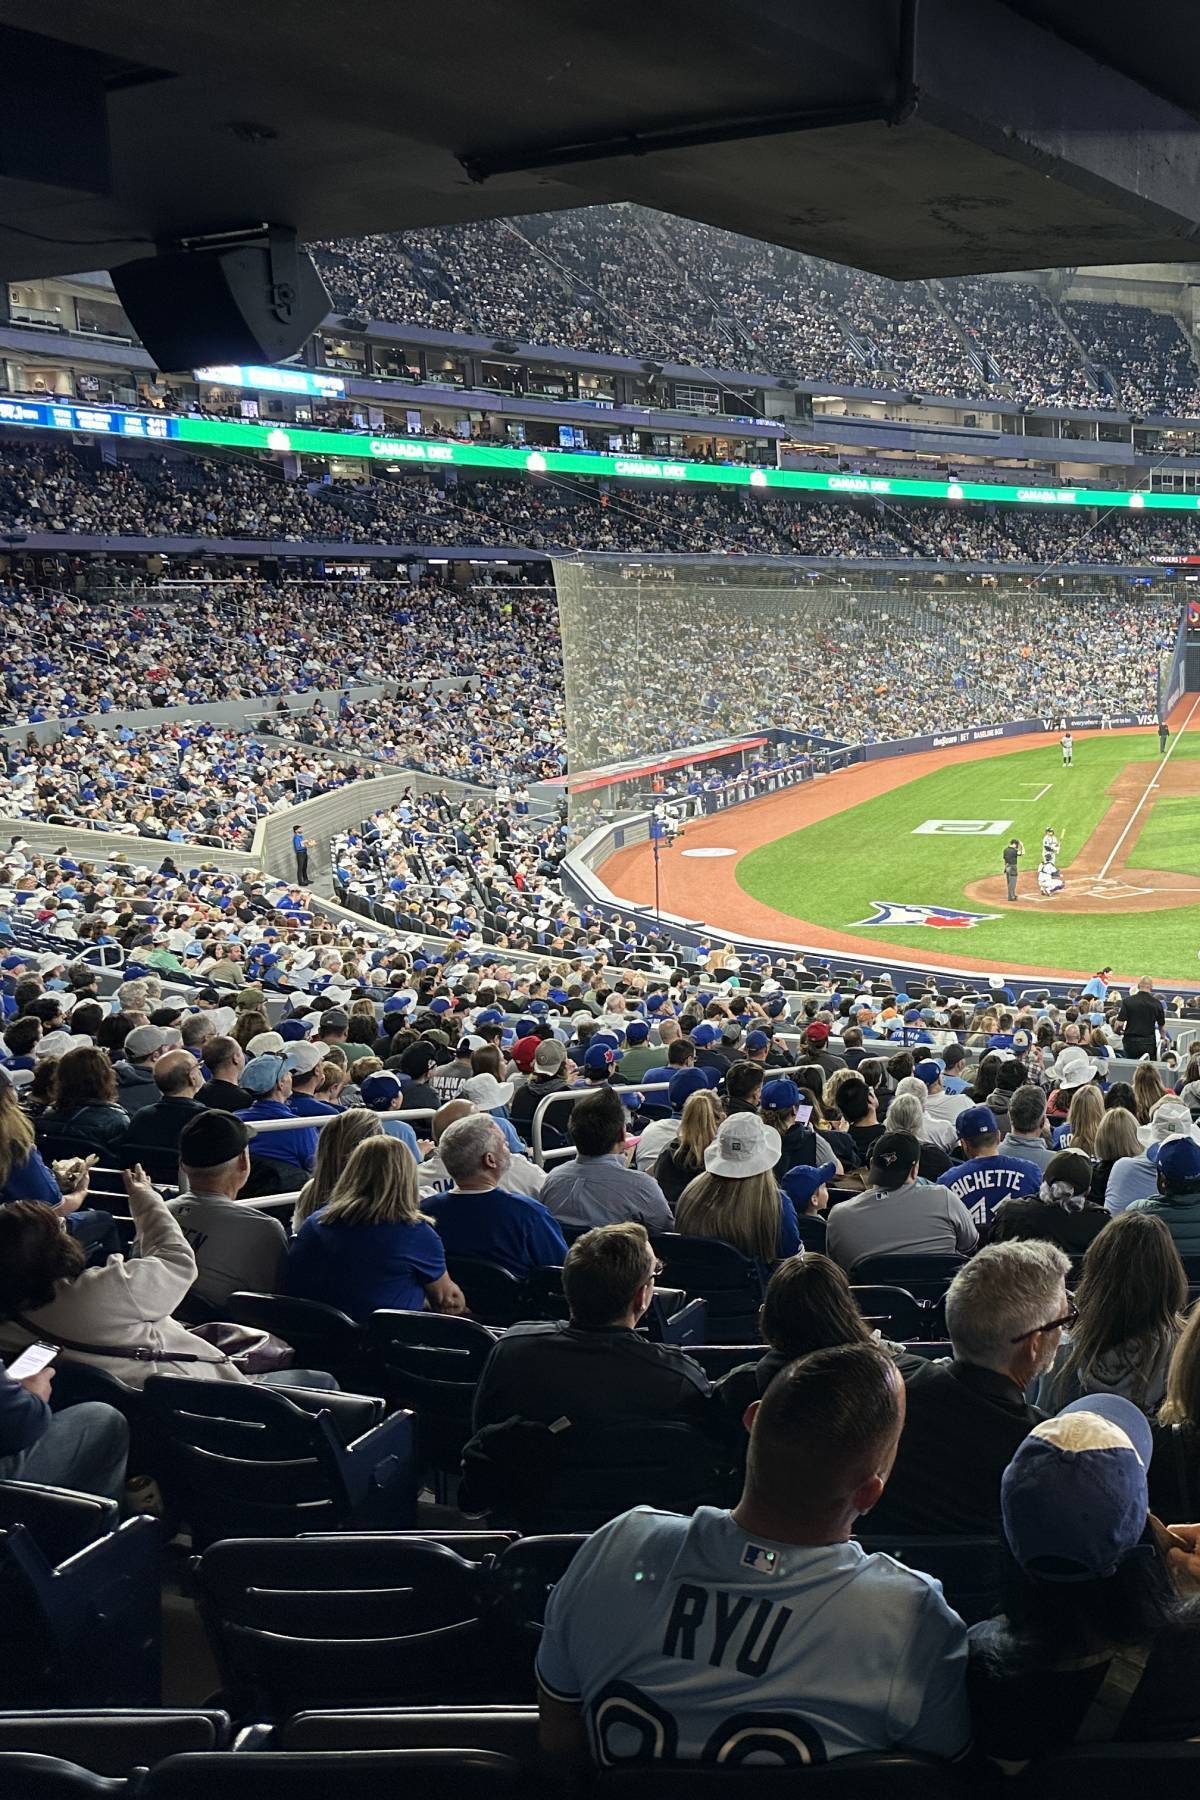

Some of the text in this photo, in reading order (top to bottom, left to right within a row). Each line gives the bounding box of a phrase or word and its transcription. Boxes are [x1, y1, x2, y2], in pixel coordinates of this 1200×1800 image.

[370, 441, 453, 460] CANADA DRY
[615, 462, 686, 478] CANADA DRY
[828, 477, 866, 492] CANADA
[1017, 488, 1051, 502] CANADA
[1042, 719, 1066, 730] VIA
[1136, 714, 1159, 725] VISA
[1060, 1133, 1074, 1149] RO
[951, 1169, 1025, 1199] BICHETTE
[662, 1583, 793, 1678] RYU
